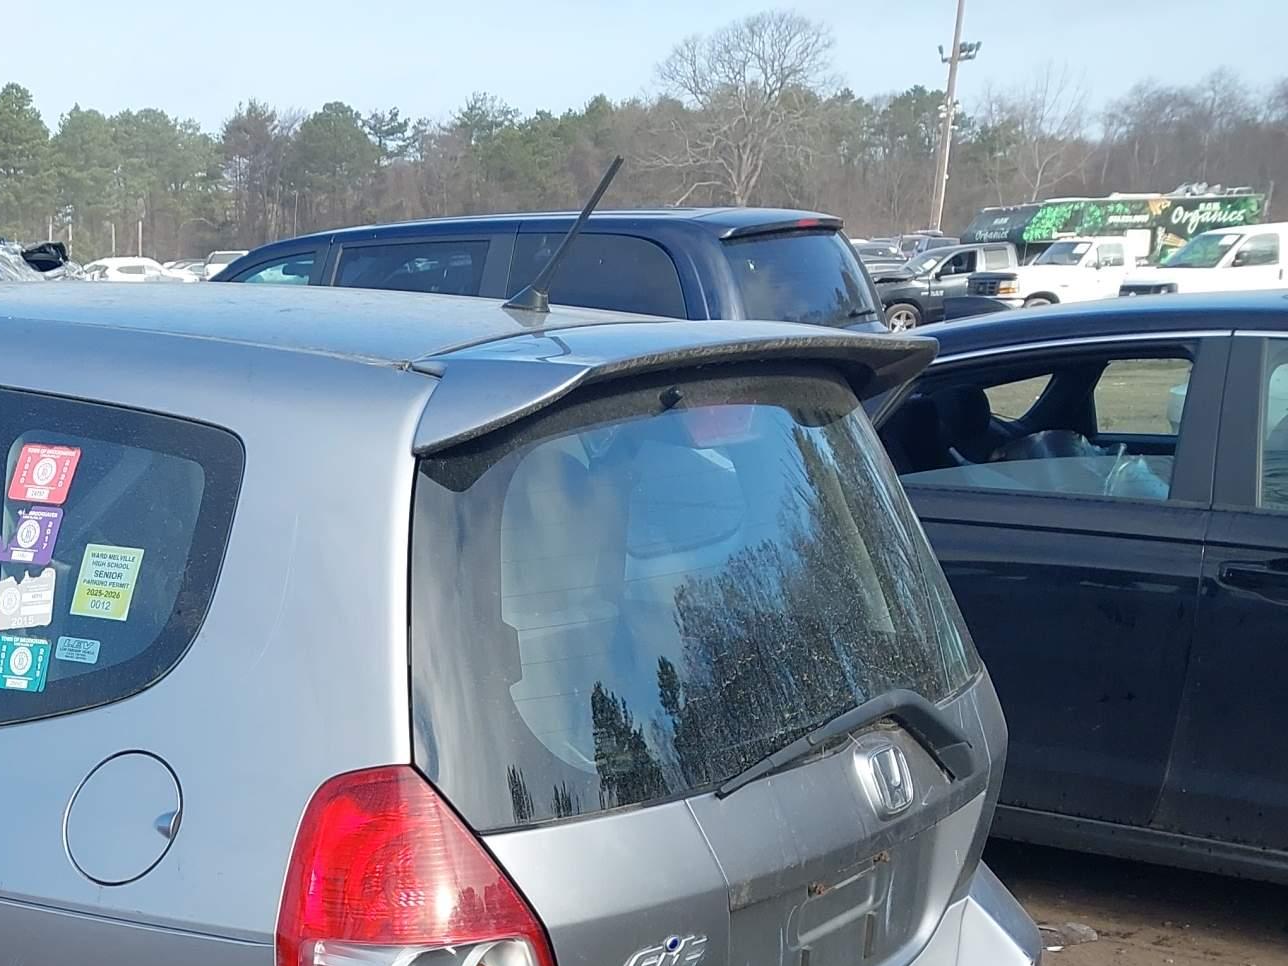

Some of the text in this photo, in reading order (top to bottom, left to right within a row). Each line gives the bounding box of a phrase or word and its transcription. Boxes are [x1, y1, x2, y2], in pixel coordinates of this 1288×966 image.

[1171, 205, 1246, 233] Organics
[108, 553, 136, 563] MELVILLE
[106, 562, 130, 570] SCHOOL
[93, 569, 123, 580] SENIOR
[82, 579, 130, 589] PARKING PERMIT
[86, 588, 121, 599] 2025-2026
[90, 599, 111, 611] 0012
[64, 639, 95, 650] LEV
